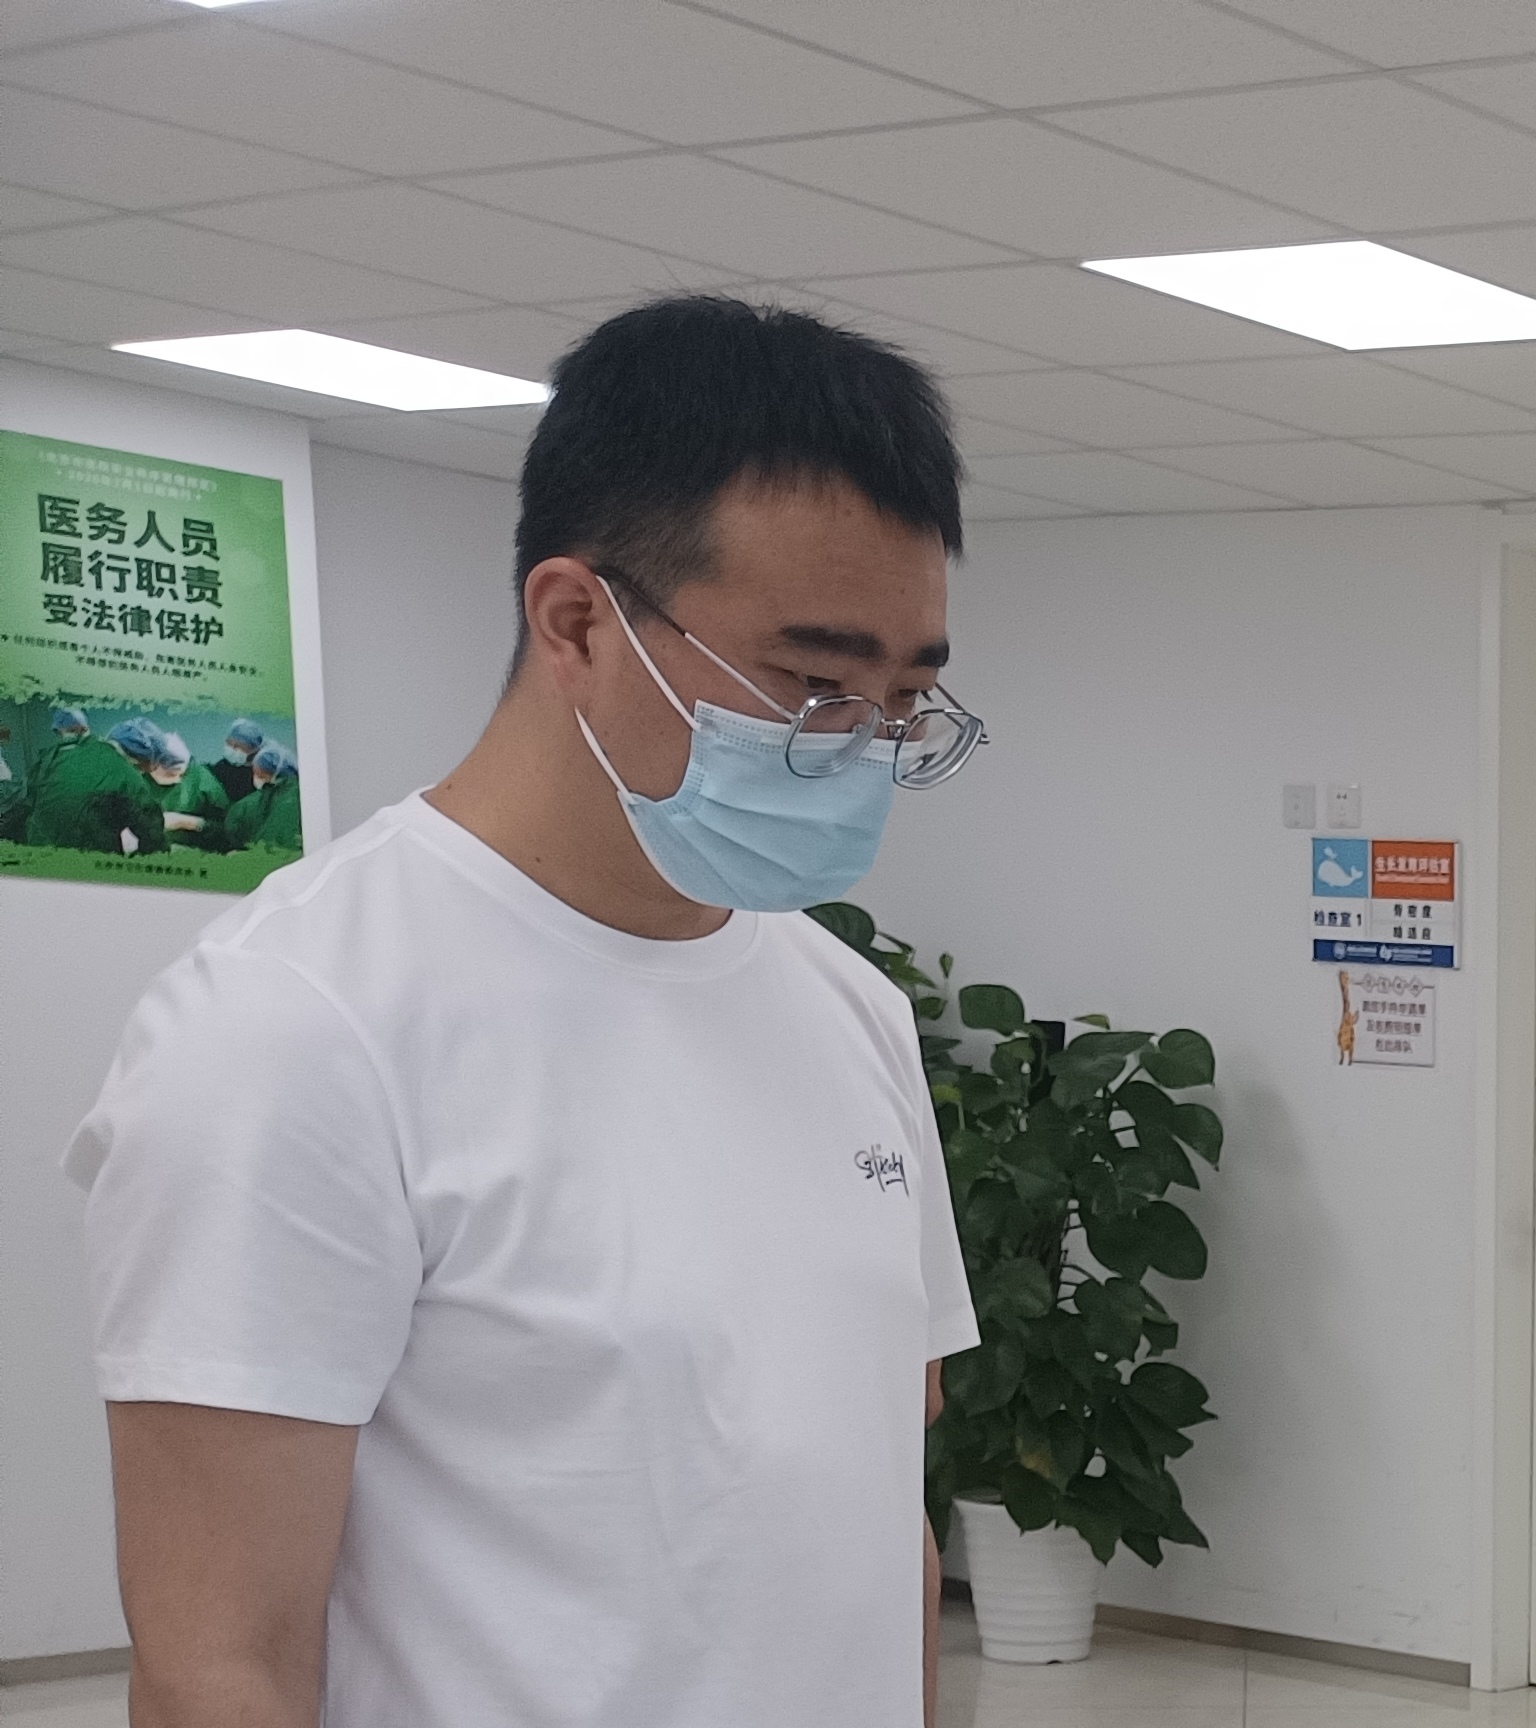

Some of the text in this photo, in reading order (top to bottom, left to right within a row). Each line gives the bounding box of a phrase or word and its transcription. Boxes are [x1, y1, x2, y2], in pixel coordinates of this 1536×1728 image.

[38, 494, 220, 561] 医务人员
[41, 542, 222, 609] 履行职责
[43, 593, 224, 645] 受法律保护
